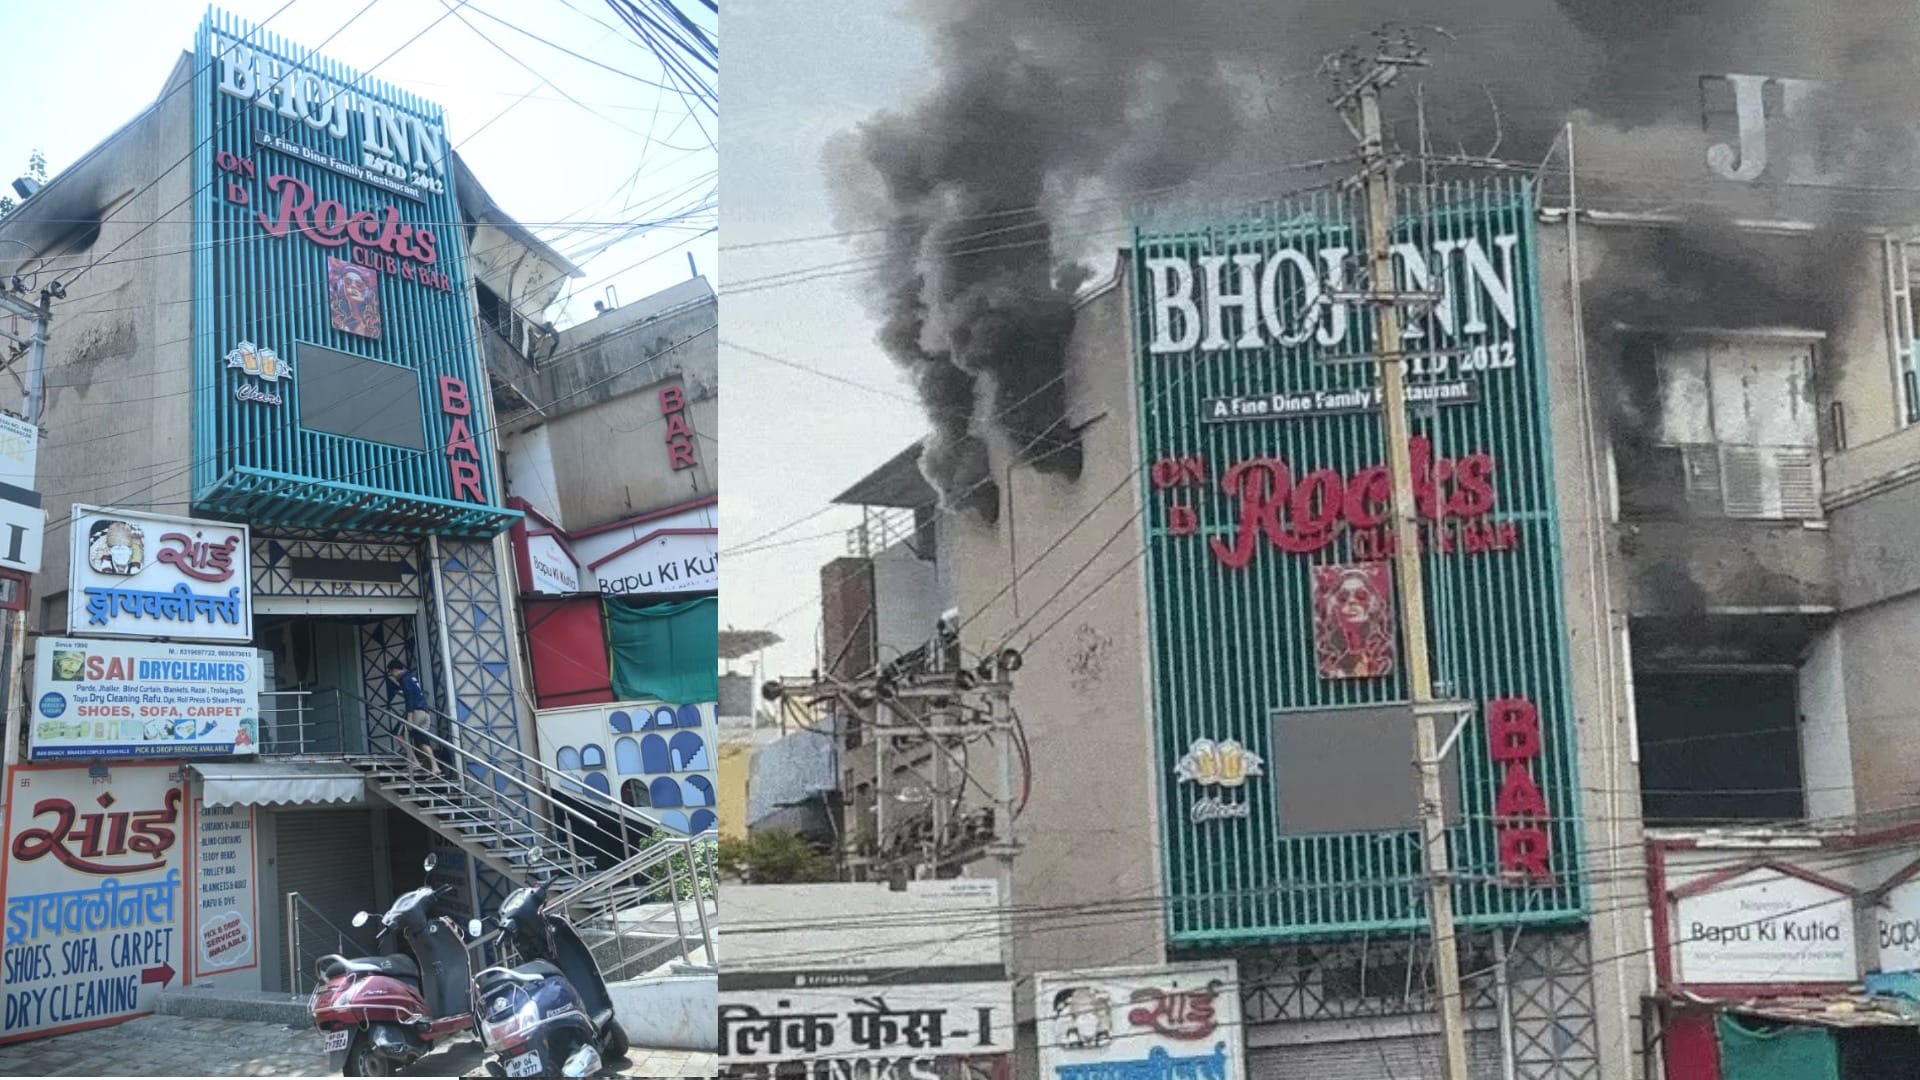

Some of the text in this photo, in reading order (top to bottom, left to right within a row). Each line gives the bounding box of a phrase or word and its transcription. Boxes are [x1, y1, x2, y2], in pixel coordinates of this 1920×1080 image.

[217, 35, 443, 177] BHOJ INN
[217, 151, 256, 180] ON
[263, 134, 420, 198] A Fine Dine Family Restaurant
[363, 152, 445, 195] ESTD 2012
[258, 175, 437, 265] Rocks
[353, 246, 452, 292] CLUB & BAR
[1145, 233, 1518, 355] BHOJ NN
[1457, 342, 1517, 371] 2012
[236, 383, 283, 406] Cheers
[1213, 400, 1228, 417] A
[1232, 396, 1267, 415] Fine
[1272, 394, 1312, 412] Dine
[1315, 388, 1370, 410] Family
[439, 375, 486, 504] BAR
[657, 386, 698, 472] BAR
[1152, 456, 1206, 489] ON
[533, 555, 552, 578] Bapu
[598, 570, 654, 595] Bapu
[657, 561, 679, 584] Ki
[84, 582, 240, 626] ड्रायक्लीनर्स
[86, 655, 246, 682] SAI DRYCLEANERS
[73, 694, 88, 703] Toys
[89, 693, 105, 704] Dry
[106, 693, 140, 704] Cleaning
[187, 706, 242, 717] CARPET
[135, 746, 149, 754] PICK
[199, 744, 230, 752] AVAILABLE
[1487, 698, 1556, 887] BAR
[202, 850, 236, 862] TEDDY BEARS
[226, 866, 236, 874] BAG
[202, 881, 230, 893] BLANKETS
[224, 896, 236, 906] DYE
[204, 928, 216, 940] PICK
[224, 918, 241, 930] DROP
[206, 928, 242, 949] SERVICES
[1691, 920, 1840, 945] Bapu Ki Kutia
[111, 928, 173, 969] CARPET
[208, 934, 247, 959] AVAILABLE
[5, 974, 138, 1031] DRY CLEANING
